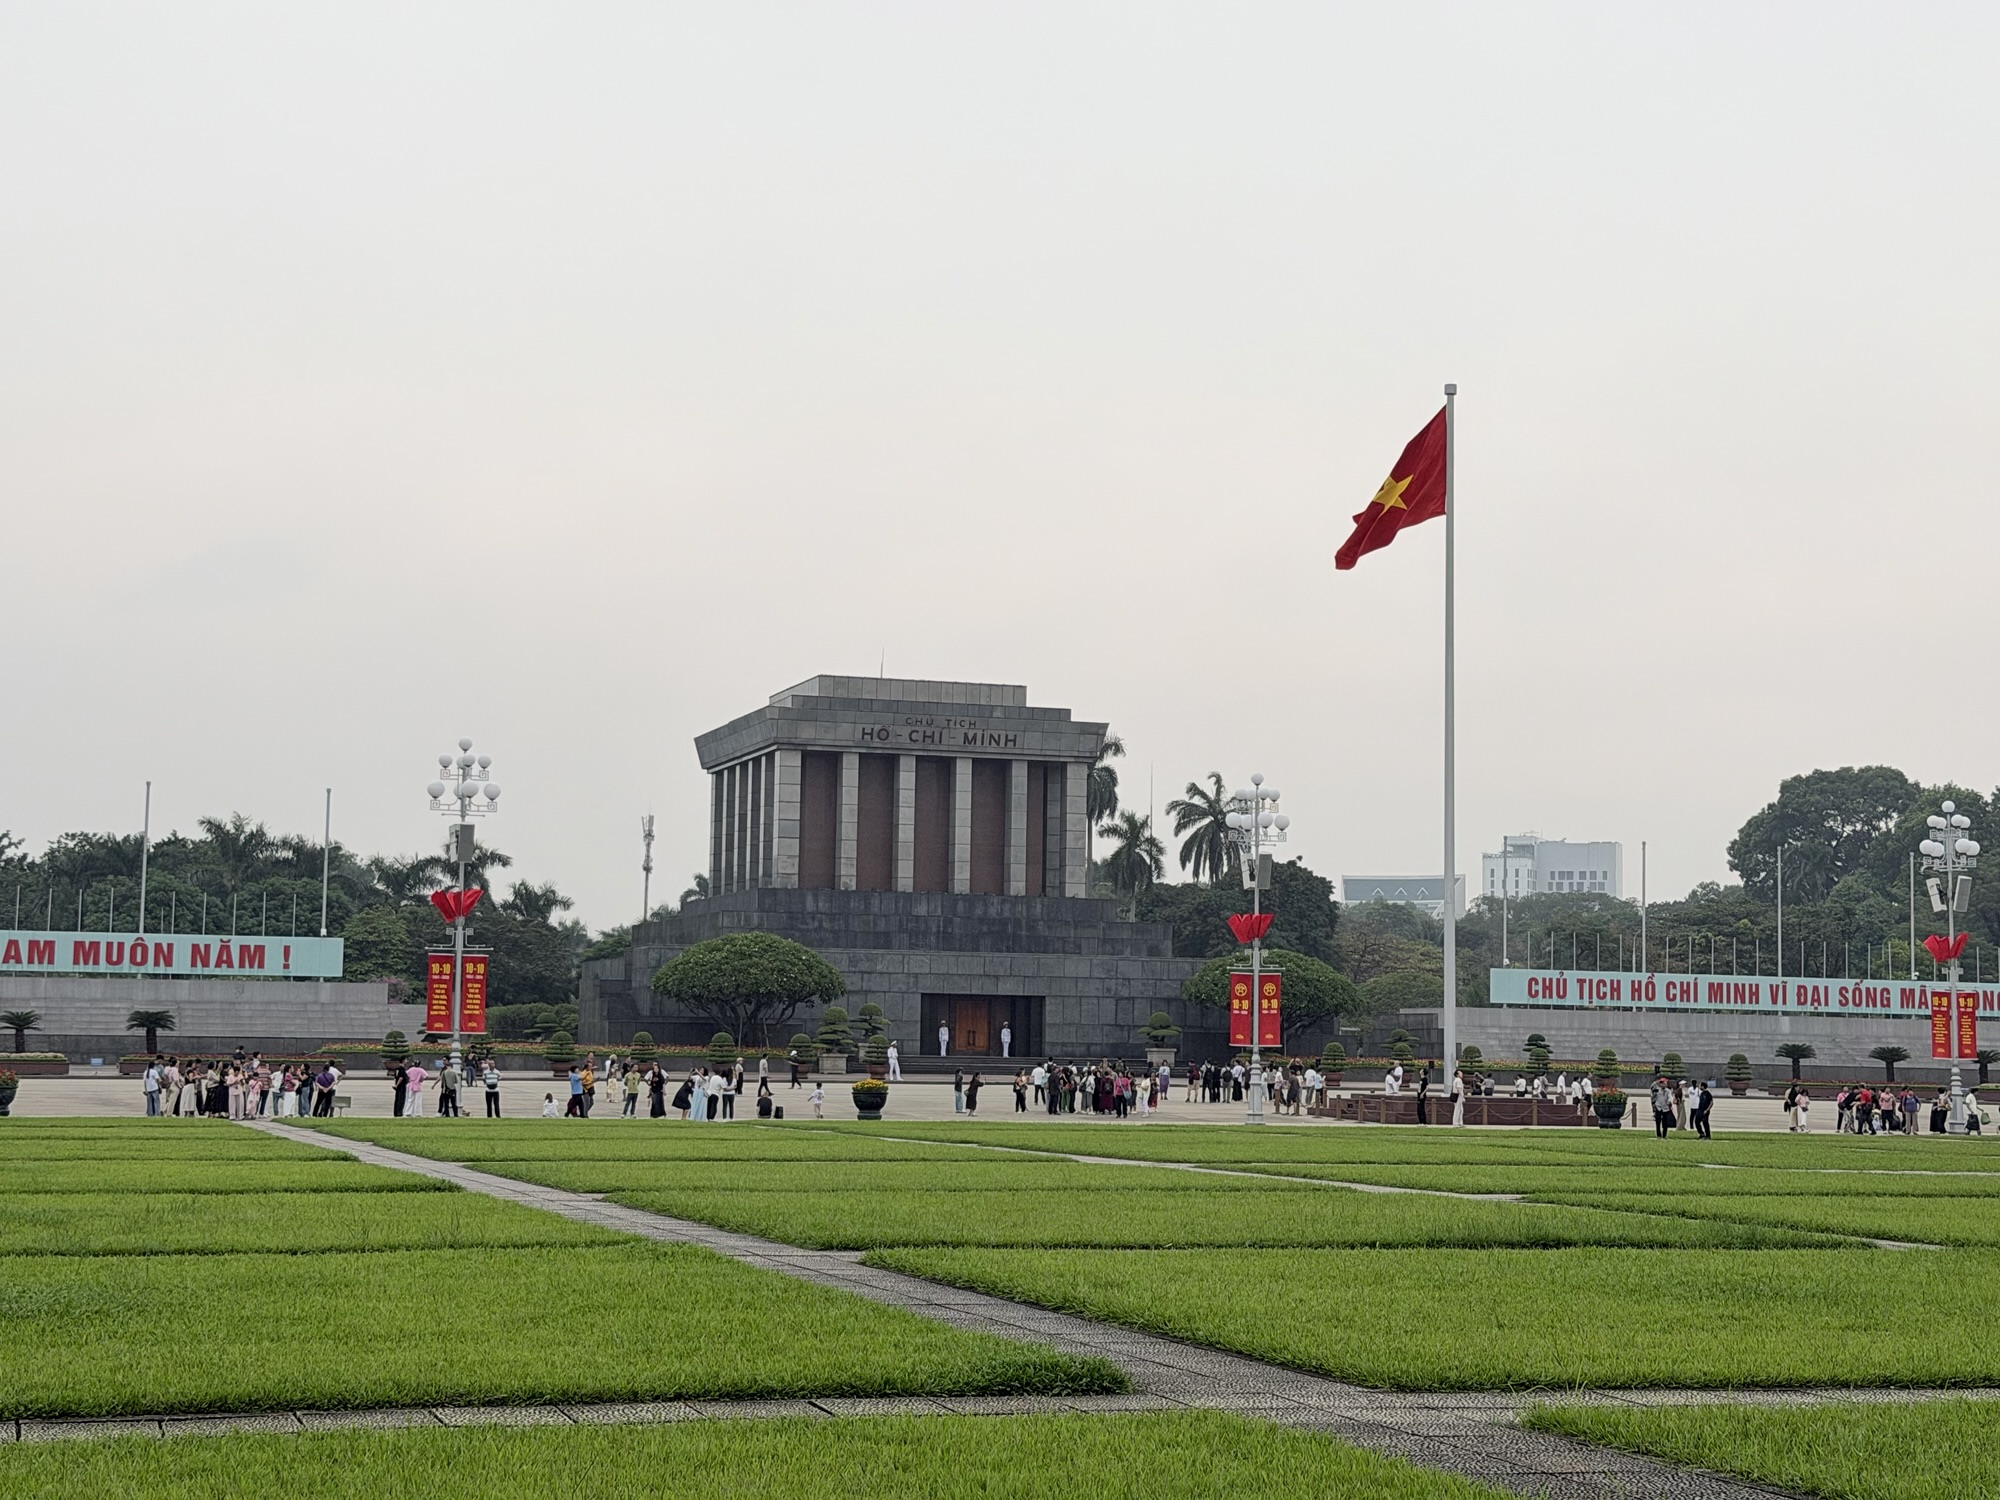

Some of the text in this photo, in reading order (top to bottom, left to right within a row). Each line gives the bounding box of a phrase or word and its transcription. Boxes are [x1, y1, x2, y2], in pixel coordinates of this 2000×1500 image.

[1, 939, 56, 965] AM
[72, 937, 174, 968] MUÔN
[190, 938, 266, 970] NĂM
[1527, 971, 1935, 1010] CHỦ TỊCH HỒ CHÍ MINH VĨ ĐẠI SỐNG MÃ
